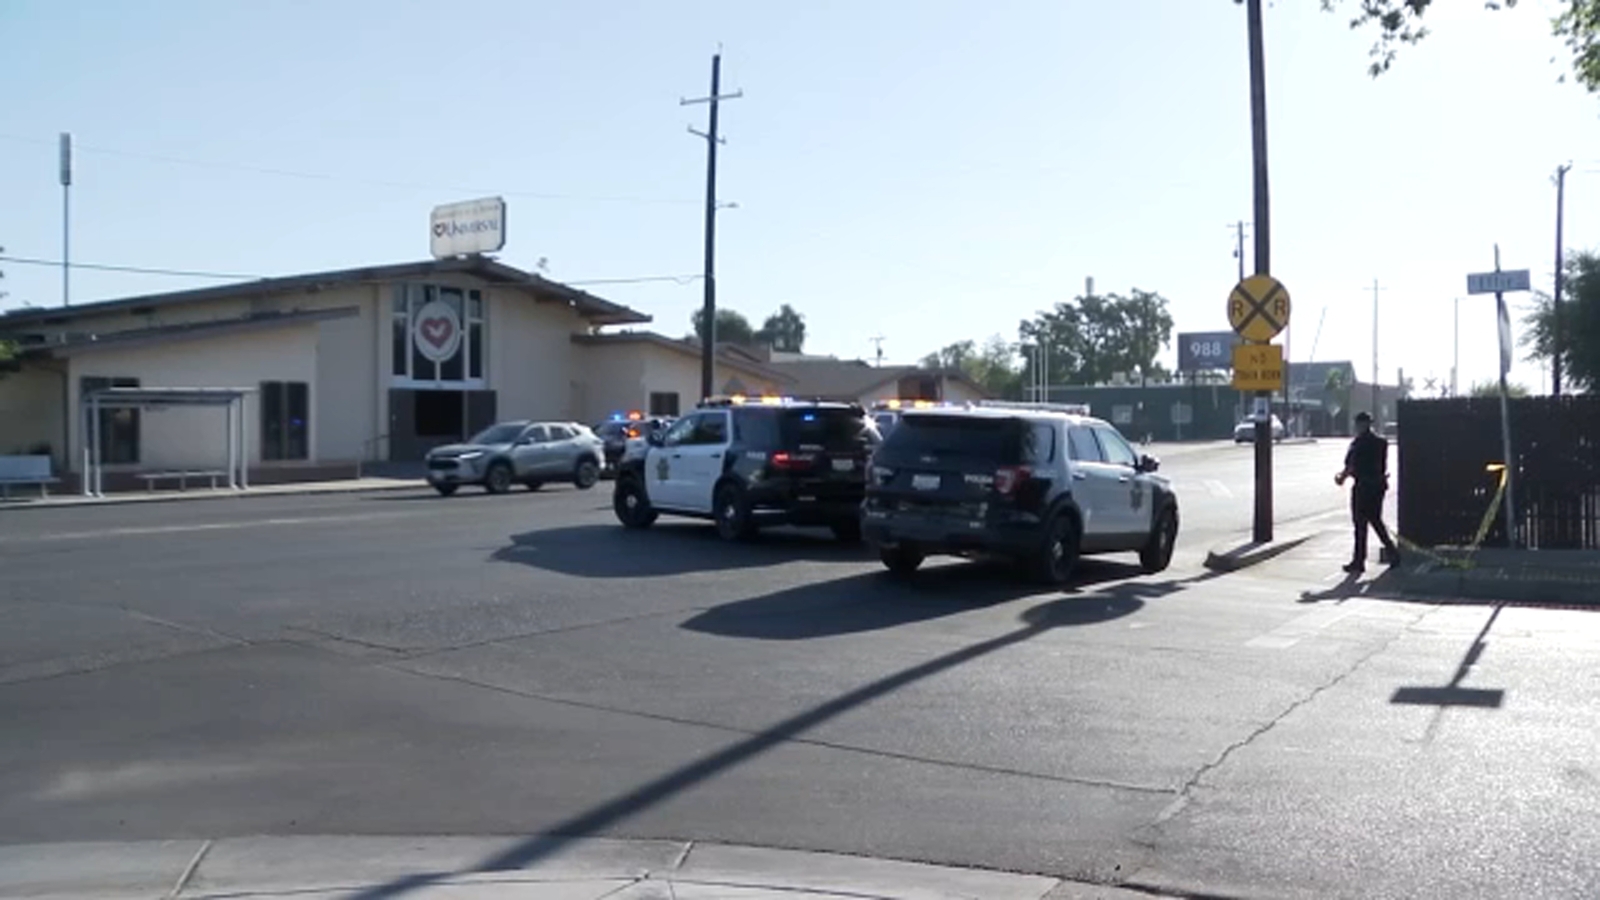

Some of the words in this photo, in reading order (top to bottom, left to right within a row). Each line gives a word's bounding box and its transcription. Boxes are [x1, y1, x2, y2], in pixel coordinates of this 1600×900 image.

[1232, 300, 1244, 317] R
[1274, 299, 1286, 316] R
[1190, 341, 1221, 357] 988
